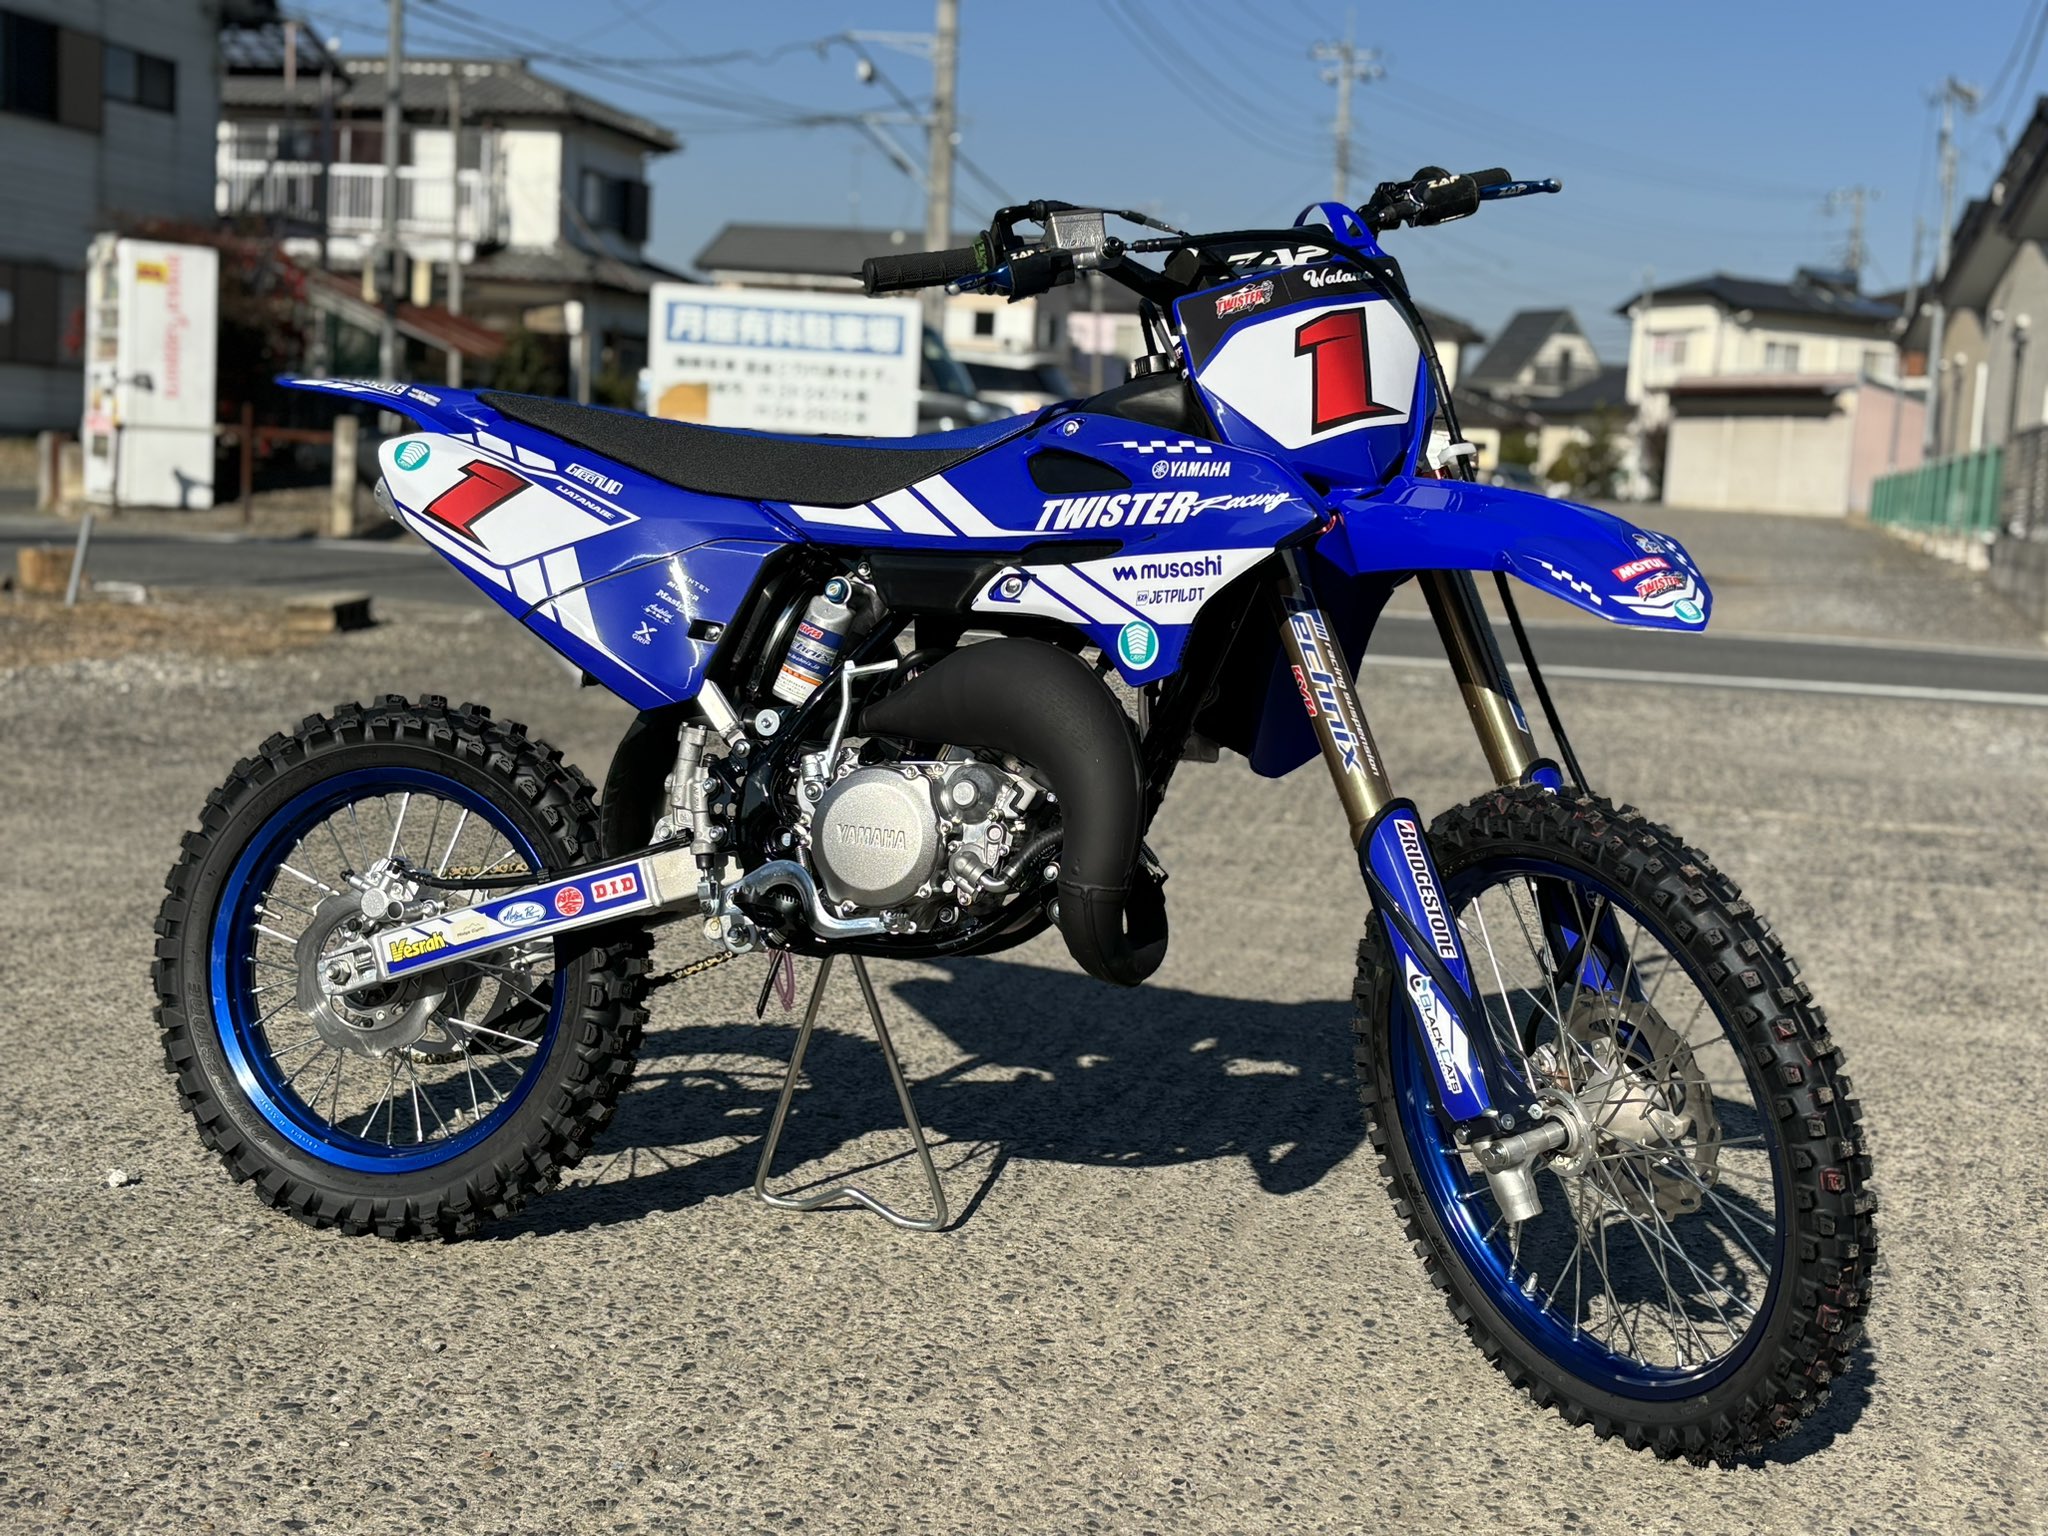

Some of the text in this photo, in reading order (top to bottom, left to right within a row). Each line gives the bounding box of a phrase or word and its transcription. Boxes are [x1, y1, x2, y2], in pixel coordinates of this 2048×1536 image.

[1427, 175, 1460, 189] ZAP
[1498, 183, 1527, 196] ZAP
[1217, 289, 1263, 314] TWISTER
[1294, 307, 1404, 435] 1
[1170, 461, 1231, 478] YAMAHA
[422, 459, 533, 552] 1
[1035, 491, 1302, 531] TWISTER Racing
[1140, 555, 1222, 579] musashi
[1619, 558, 1668, 579] MOTUL
[1149, 587, 1205, 604] JETPILOT
[1638, 576, 1681, 598] TWISTER
[631, 633, 651, 645] GRIP
[1323, 641, 1380, 776] racing suspension
[836, 823, 907, 850] YAMAHA
[1396, 821, 1457, 958] BRIDGESTONE
[390, 932, 446, 962] Vesrah
